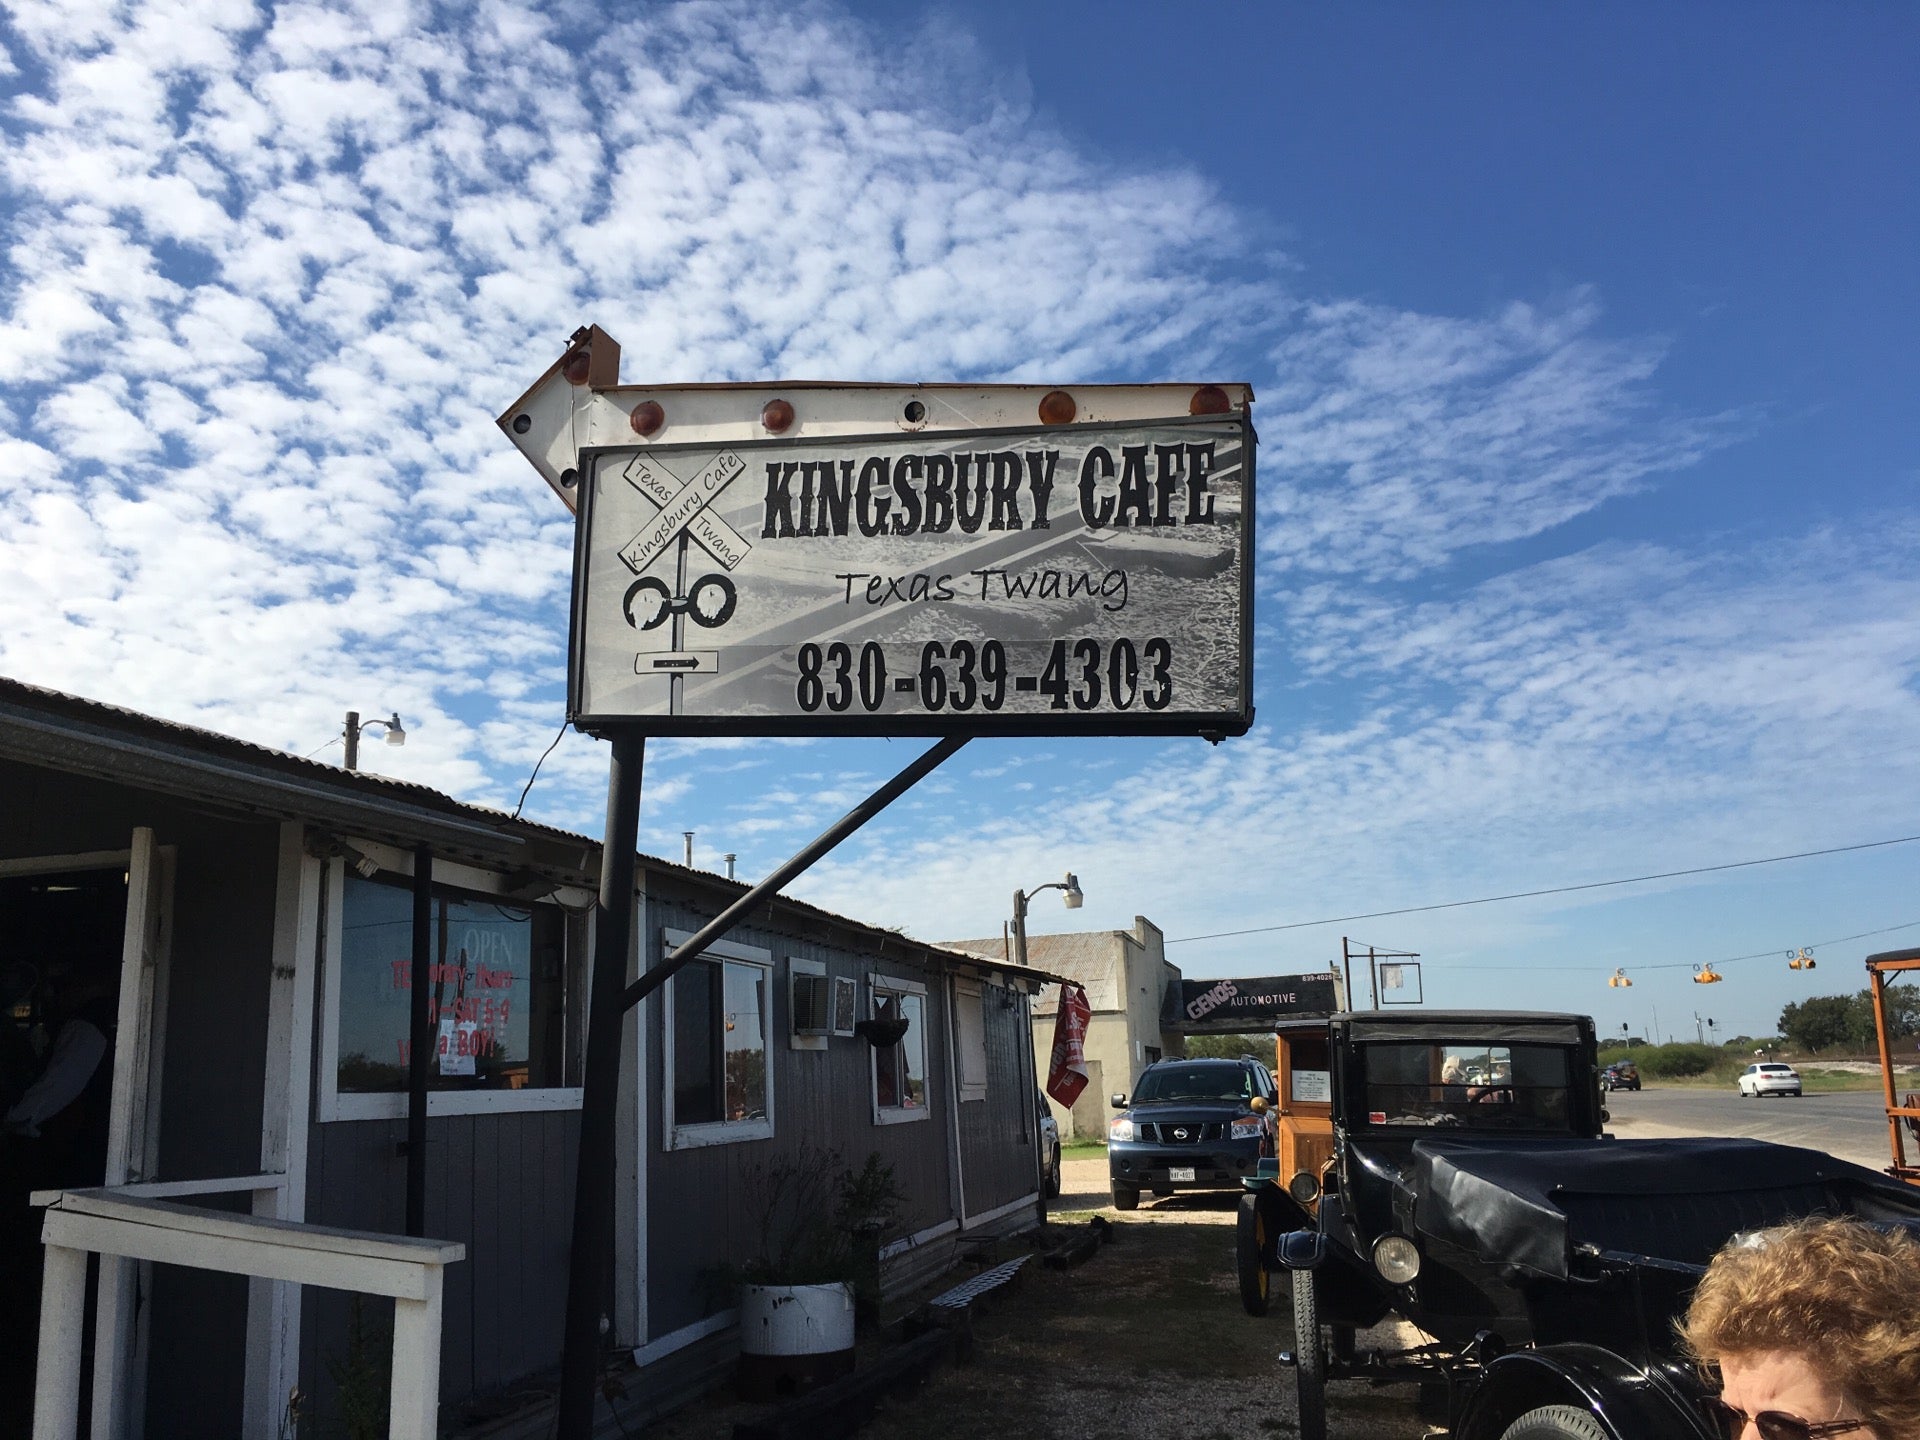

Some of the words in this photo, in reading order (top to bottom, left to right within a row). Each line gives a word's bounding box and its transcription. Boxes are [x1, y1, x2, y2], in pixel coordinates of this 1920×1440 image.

[635, 463, 673, 501] Texas
[761, 448, 1060, 539] KINGSBURY
[1077, 441, 1217, 531] CAFE
[628, 491, 703, 568] Kingsbury
[704, 455, 737, 491] Cafe
[696, 516, 740, 567] Twang
[836, 572, 955, 606] Texas
[970, 568, 1130, 611] Twang
[798, 637, 1172, 712] 830-639-4303
[465, 928, 512, 965] OPEN
[391, 960, 465, 990] TEorary
[1230, 993, 1297, 1007] AUTOMOTIVE
[458, 1026, 495, 1058] BOY!
